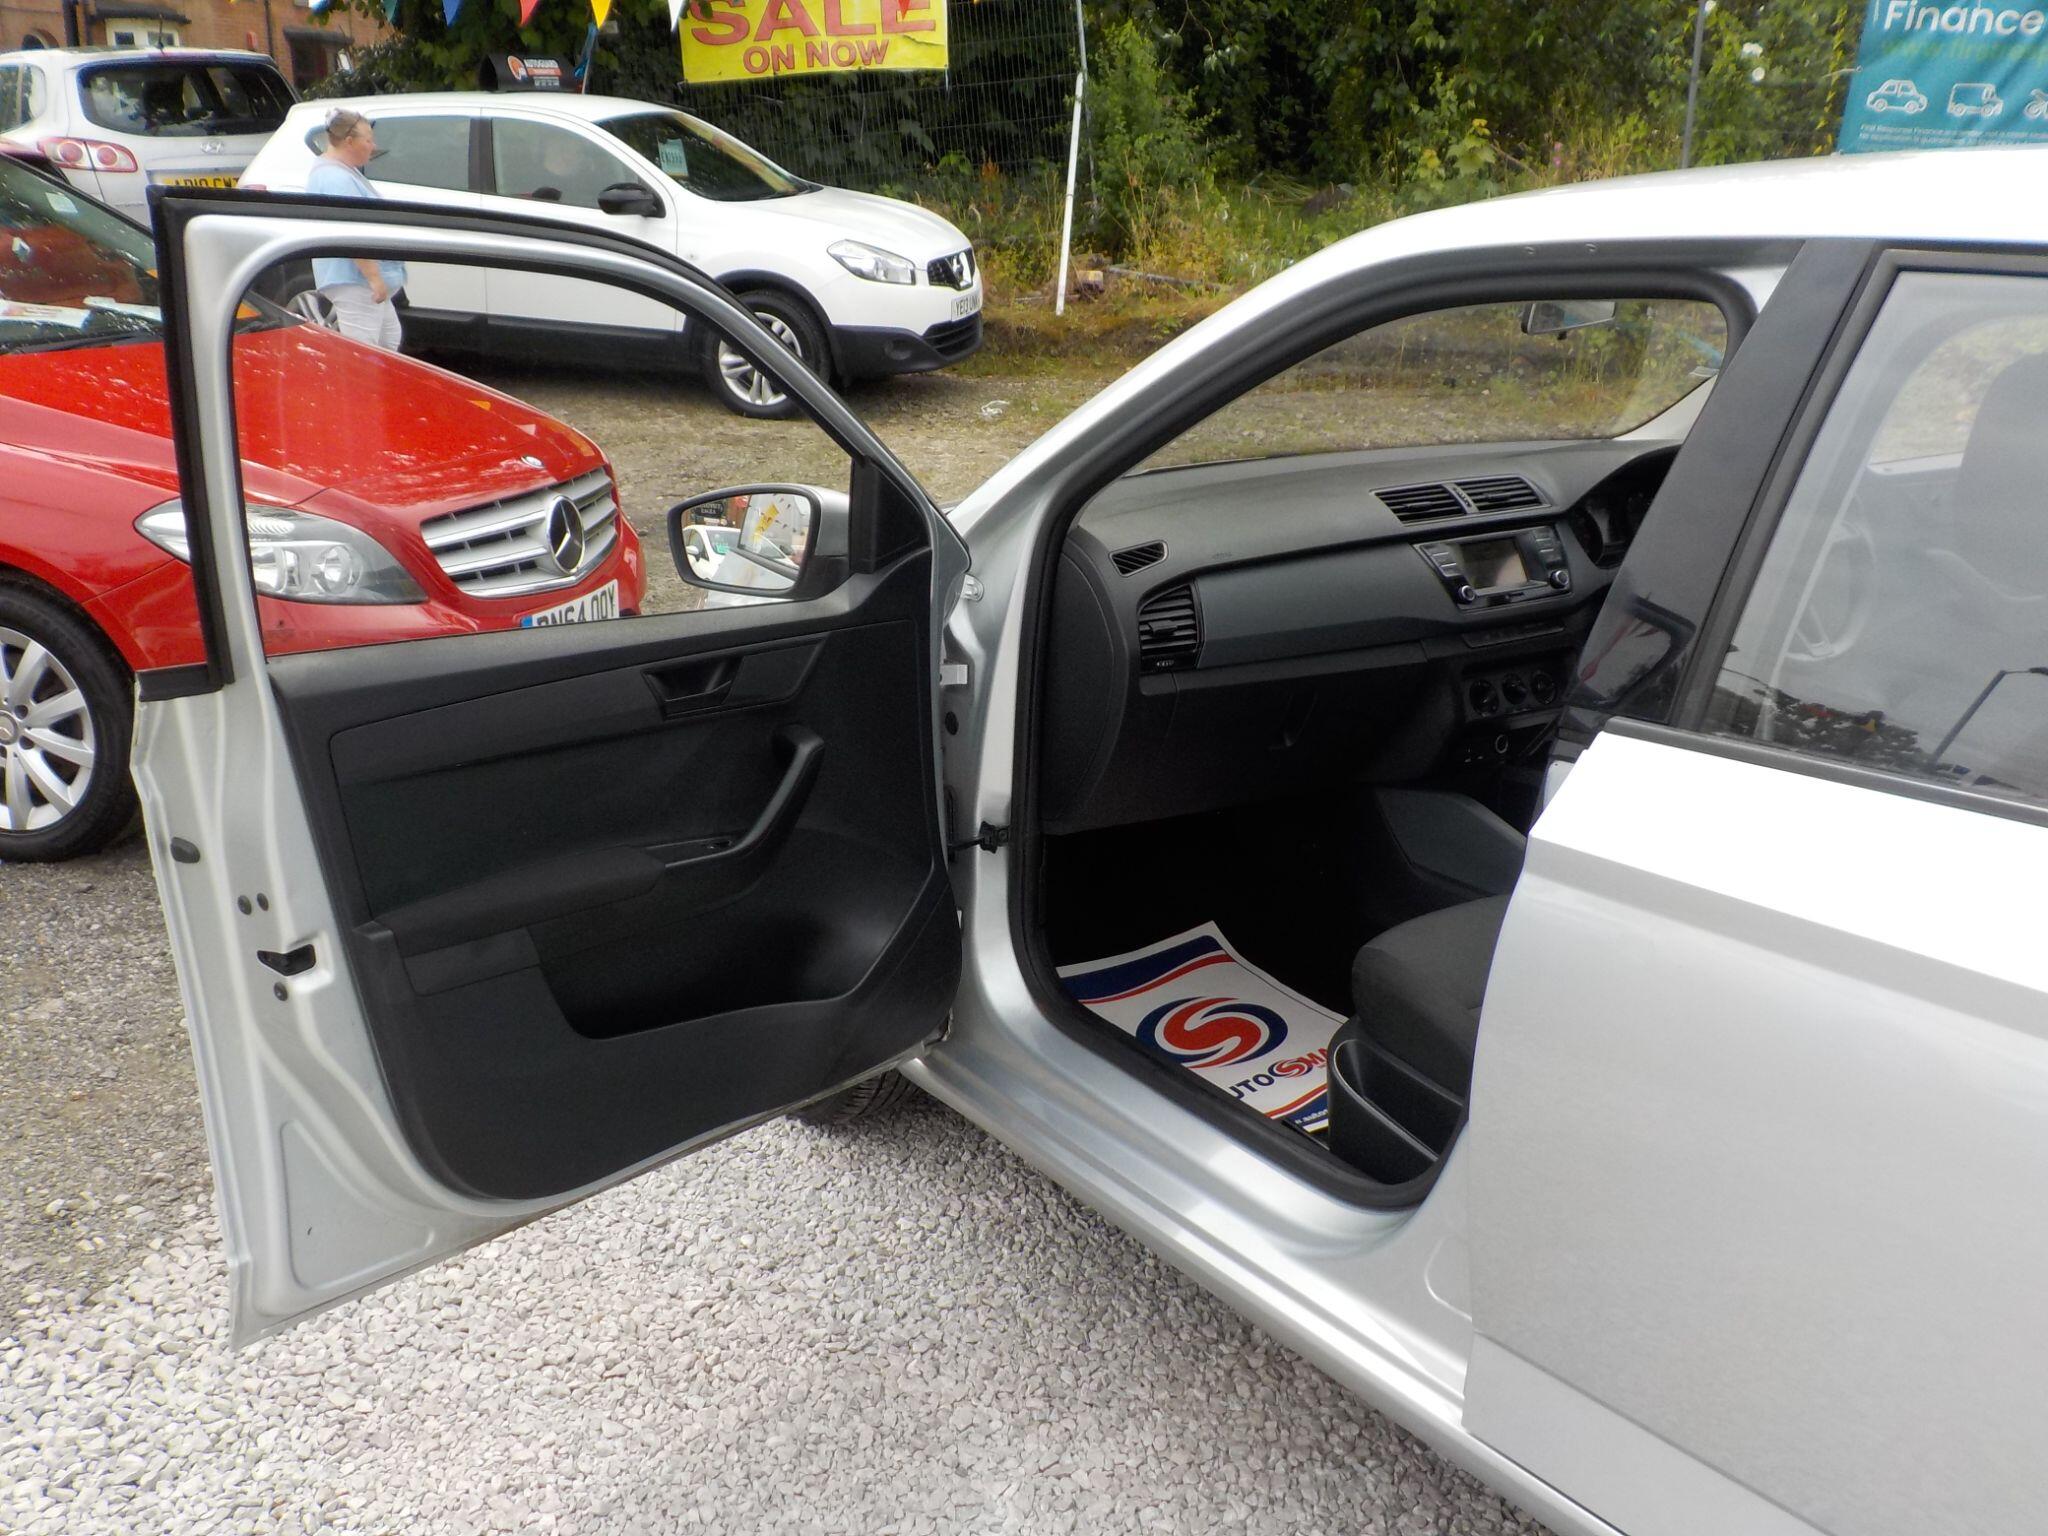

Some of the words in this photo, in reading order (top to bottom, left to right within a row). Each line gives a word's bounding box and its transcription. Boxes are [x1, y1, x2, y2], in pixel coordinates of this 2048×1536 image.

[689, 0, 936, 46] SALE
[1884, 0, 2045, 36] Finance
[743, 43, 796, 74] ON
[806, 39, 890, 68] NOW
